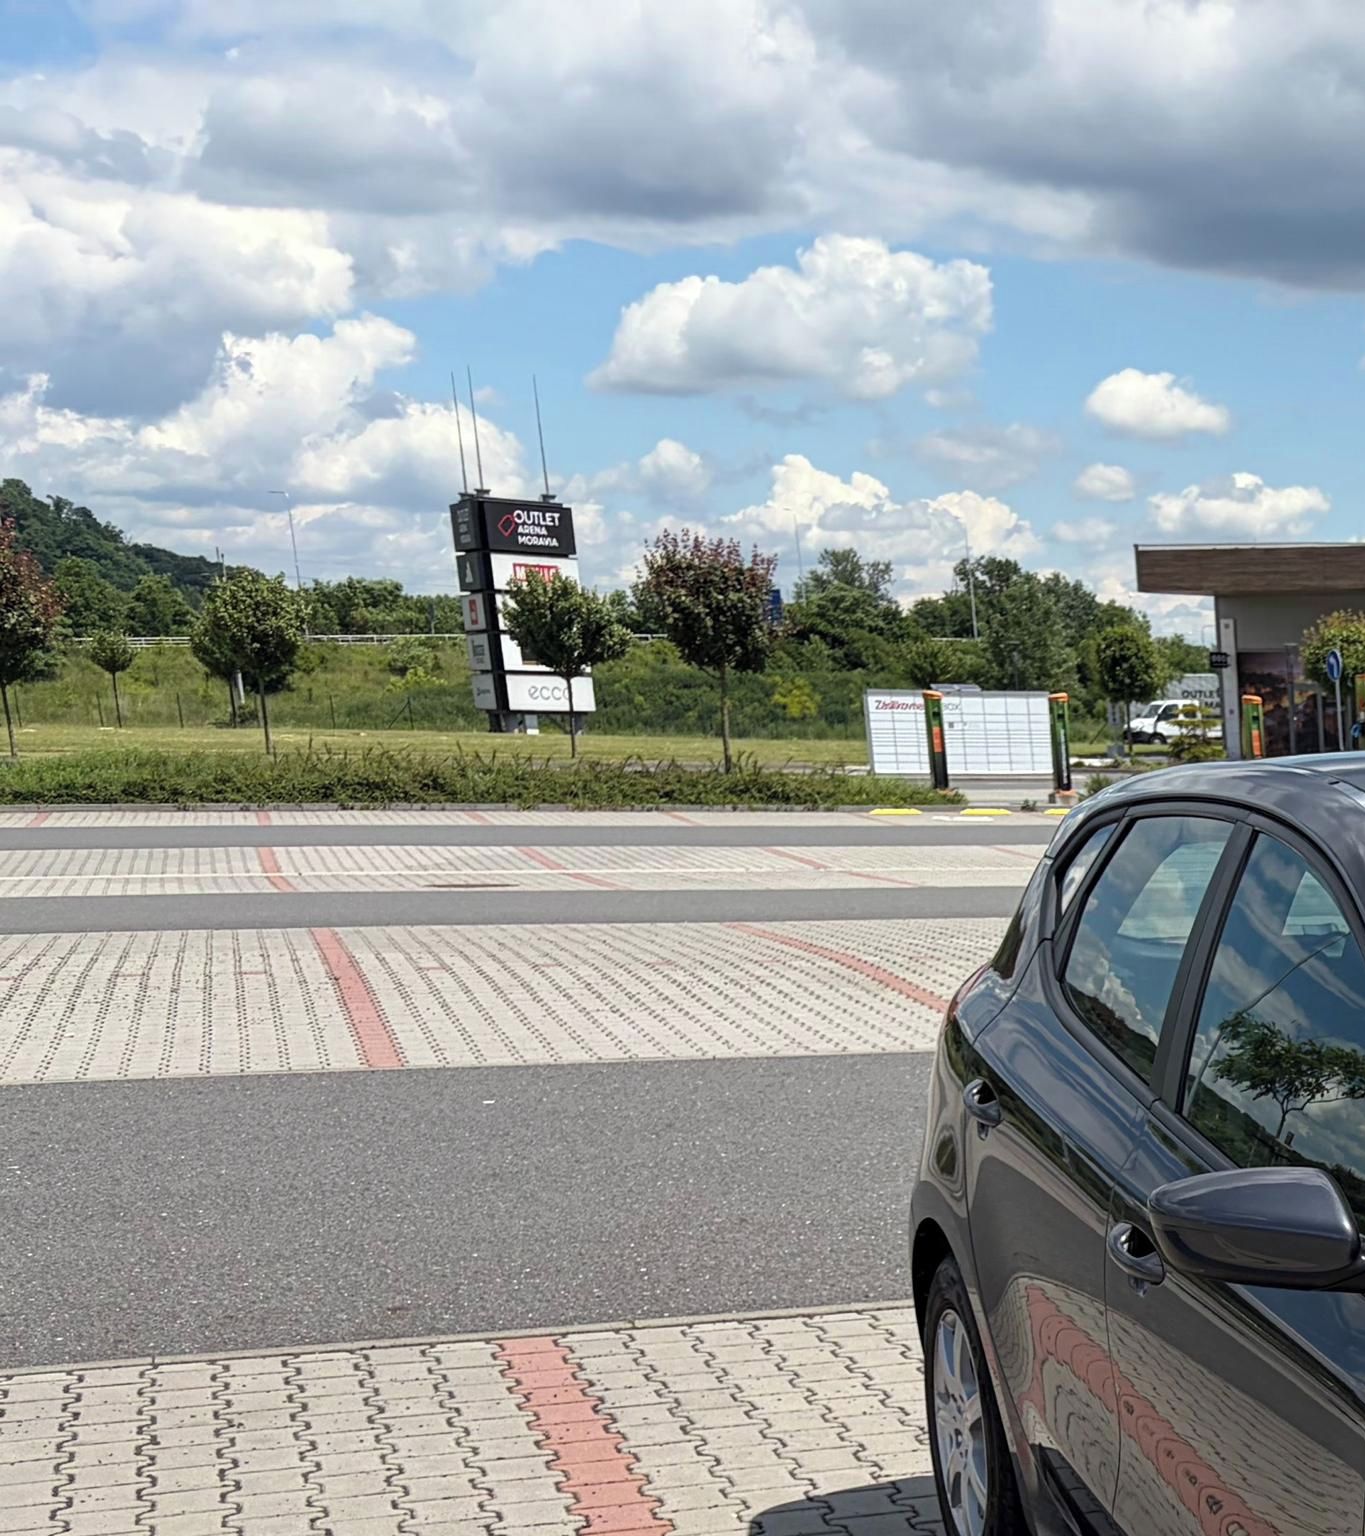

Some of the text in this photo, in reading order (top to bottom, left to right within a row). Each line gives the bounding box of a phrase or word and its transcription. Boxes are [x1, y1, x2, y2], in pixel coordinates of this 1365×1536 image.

[513, 510, 560, 526] OUTLET
[517, 526, 548, 536] ARENA
[518, 535, 559, 547] MORAVIA
